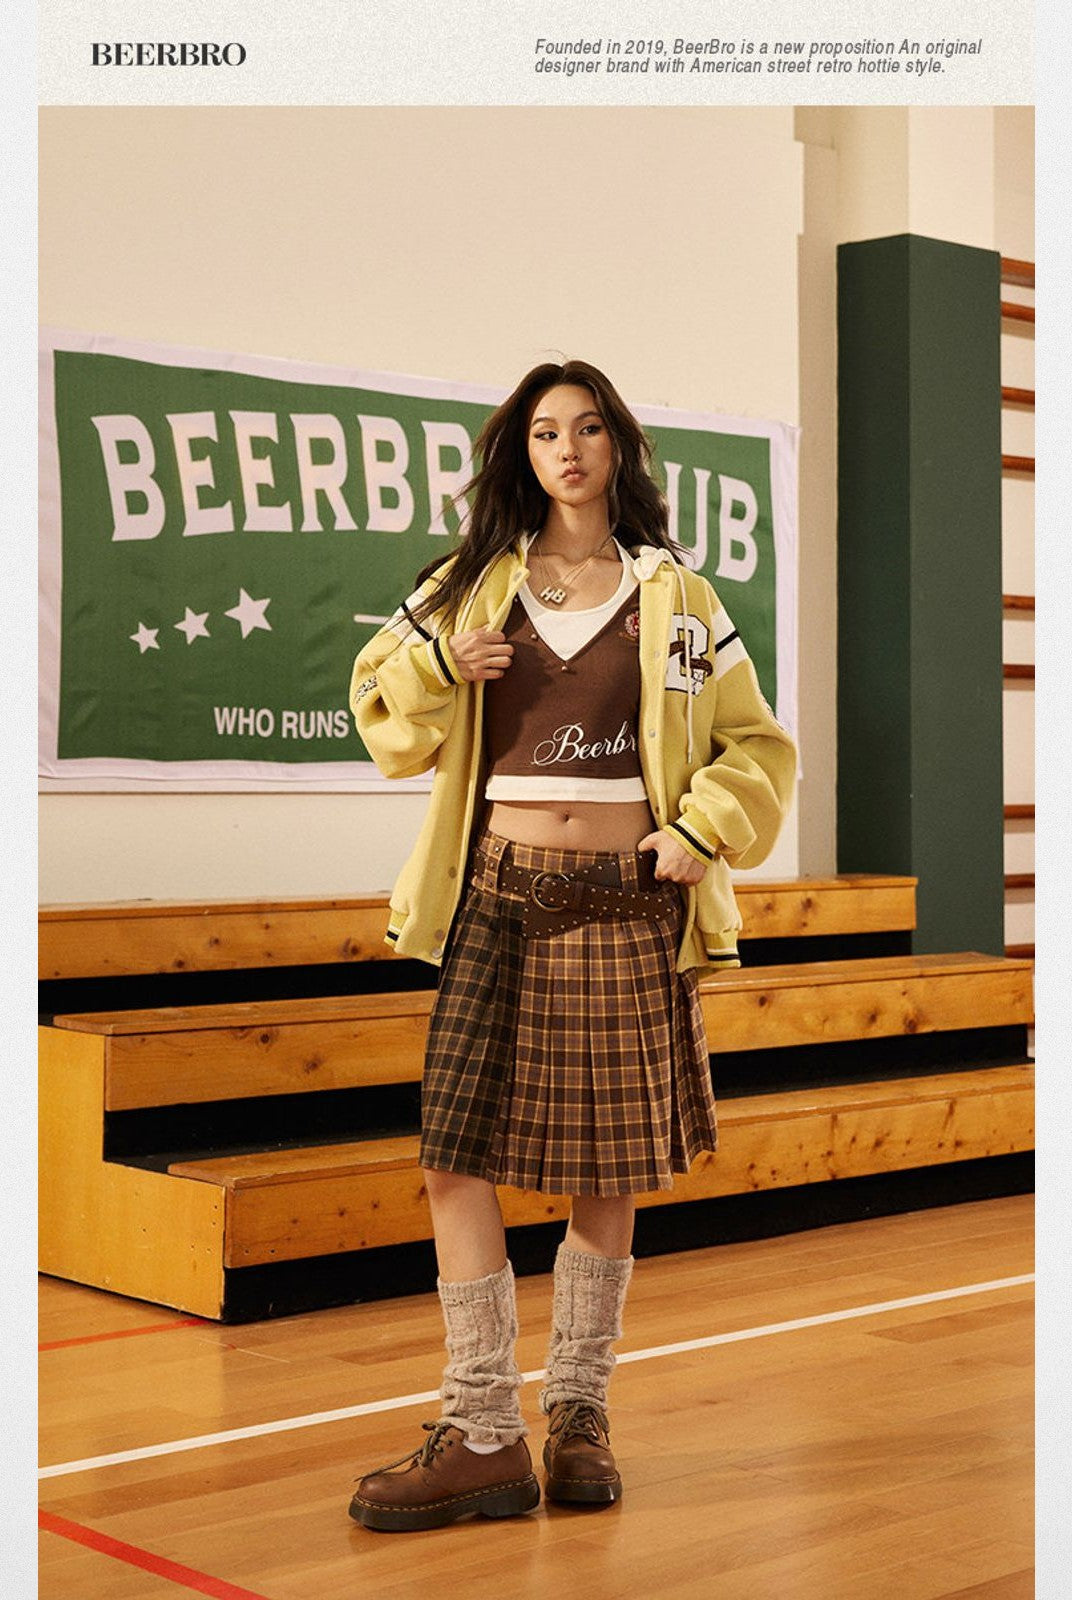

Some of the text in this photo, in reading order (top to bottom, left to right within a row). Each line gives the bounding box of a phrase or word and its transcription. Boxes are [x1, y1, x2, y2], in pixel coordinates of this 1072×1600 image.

[90, 410, 758, 582] BEERBR UB
[213, 706, 350, 739] WHO RUNS
[530, 720, 637, 767] Beerbr
